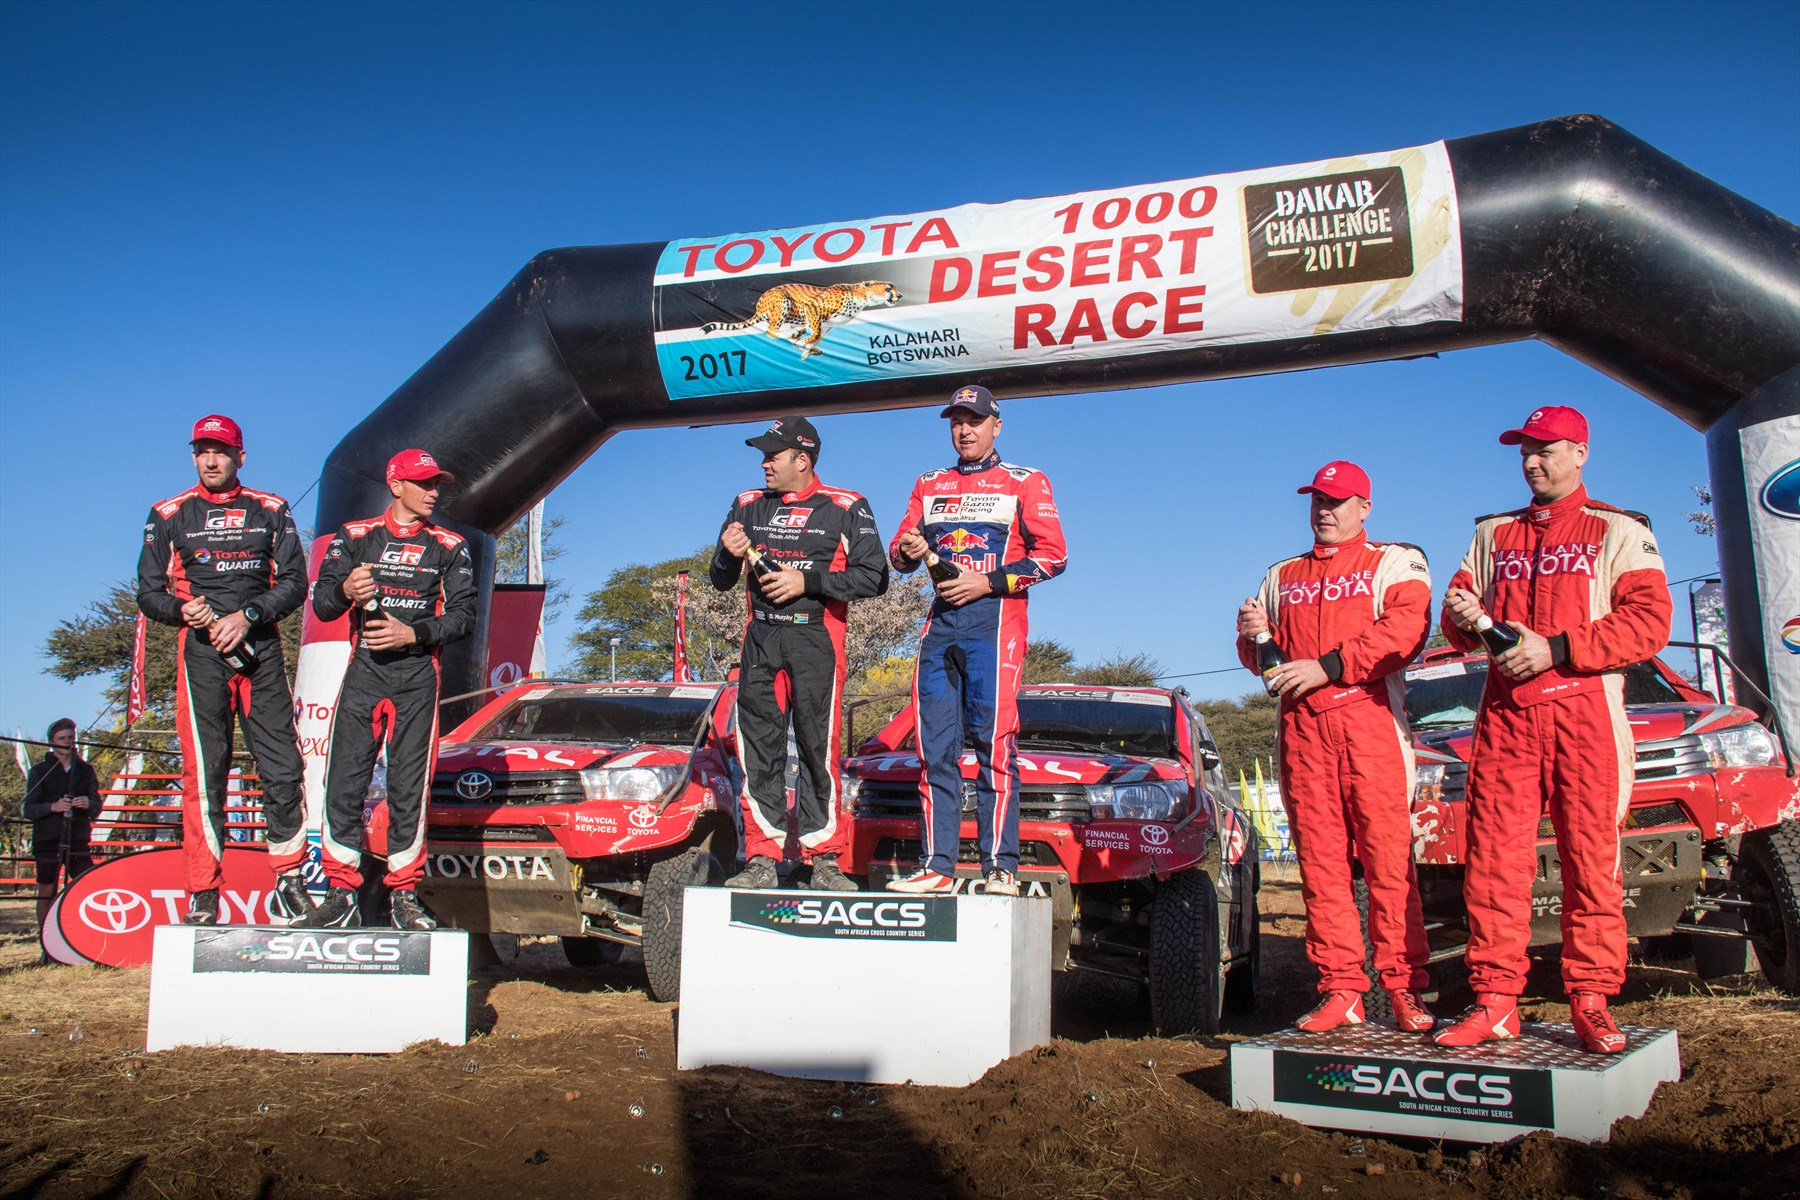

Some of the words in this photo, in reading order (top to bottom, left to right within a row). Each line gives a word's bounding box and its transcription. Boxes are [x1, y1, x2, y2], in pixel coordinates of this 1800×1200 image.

[1275, 180, 1375, 217] DAKAR
[677, 217, 960, 278] TOYOTA
[1053, 185, 1218, 235] 1000
[1265, 207, 1393, 247] CHALLENGE
[928, 226, 1214, 304] DESERT
[1304, 240, 1358, 272] 2017
[1013, 285, 1206, 350] RACE
[869, 328, 960, 349] KALAHARI
[867, 344, 969, 365] BOTSWANA
[680, 350, 747, 381] 2017
[931, 502, 960, 515] GR
[207, 516, 244, 528] GR
[773, 514, 806, 527] GR
[212, 550, 255, 559] TOTAL
[382, 551, 421, 565] GR
[770, 548, 808, 558] TOTAL
[216, 560, 261, 571] QUARTZ
[416, 566, 439, 574] Racing
[1495, 553, 1592, 580] TOYOTA
[1280, 570, 1372, 591] MALALANE
[382, 585, 422, 597] TOTAL
[1280, 580, 1370, 606] TOYOTA
[381, 596, 427, 609] QUARTZ
[575, 815, 618, 825] FINANCIAL
[575, 824, 618, 834] SERVICES
[1085, 830, 1130, 840] FINANCIAL
[1085, 839, 1130, 850] SERVICES
[1140, 845, 1173, 855] TOYOTA
[424, 854, 555, 880] TOYOTA
[798, 901, 926, 928] SACCS
[267, 937, 401, 961] SACCS
[1352, 1065, 1512, 1106] SACCS
[1399, 1101, 1417, 1110] SOUTH
[1418, 1103, 1442, 1112] AFRICAN
[1443, 1105, 1462, 1114] CROSS
[1462, 1107, 1488, 1116] COUNTRY
[1490, 1109, 1514, 1119] SERIES
